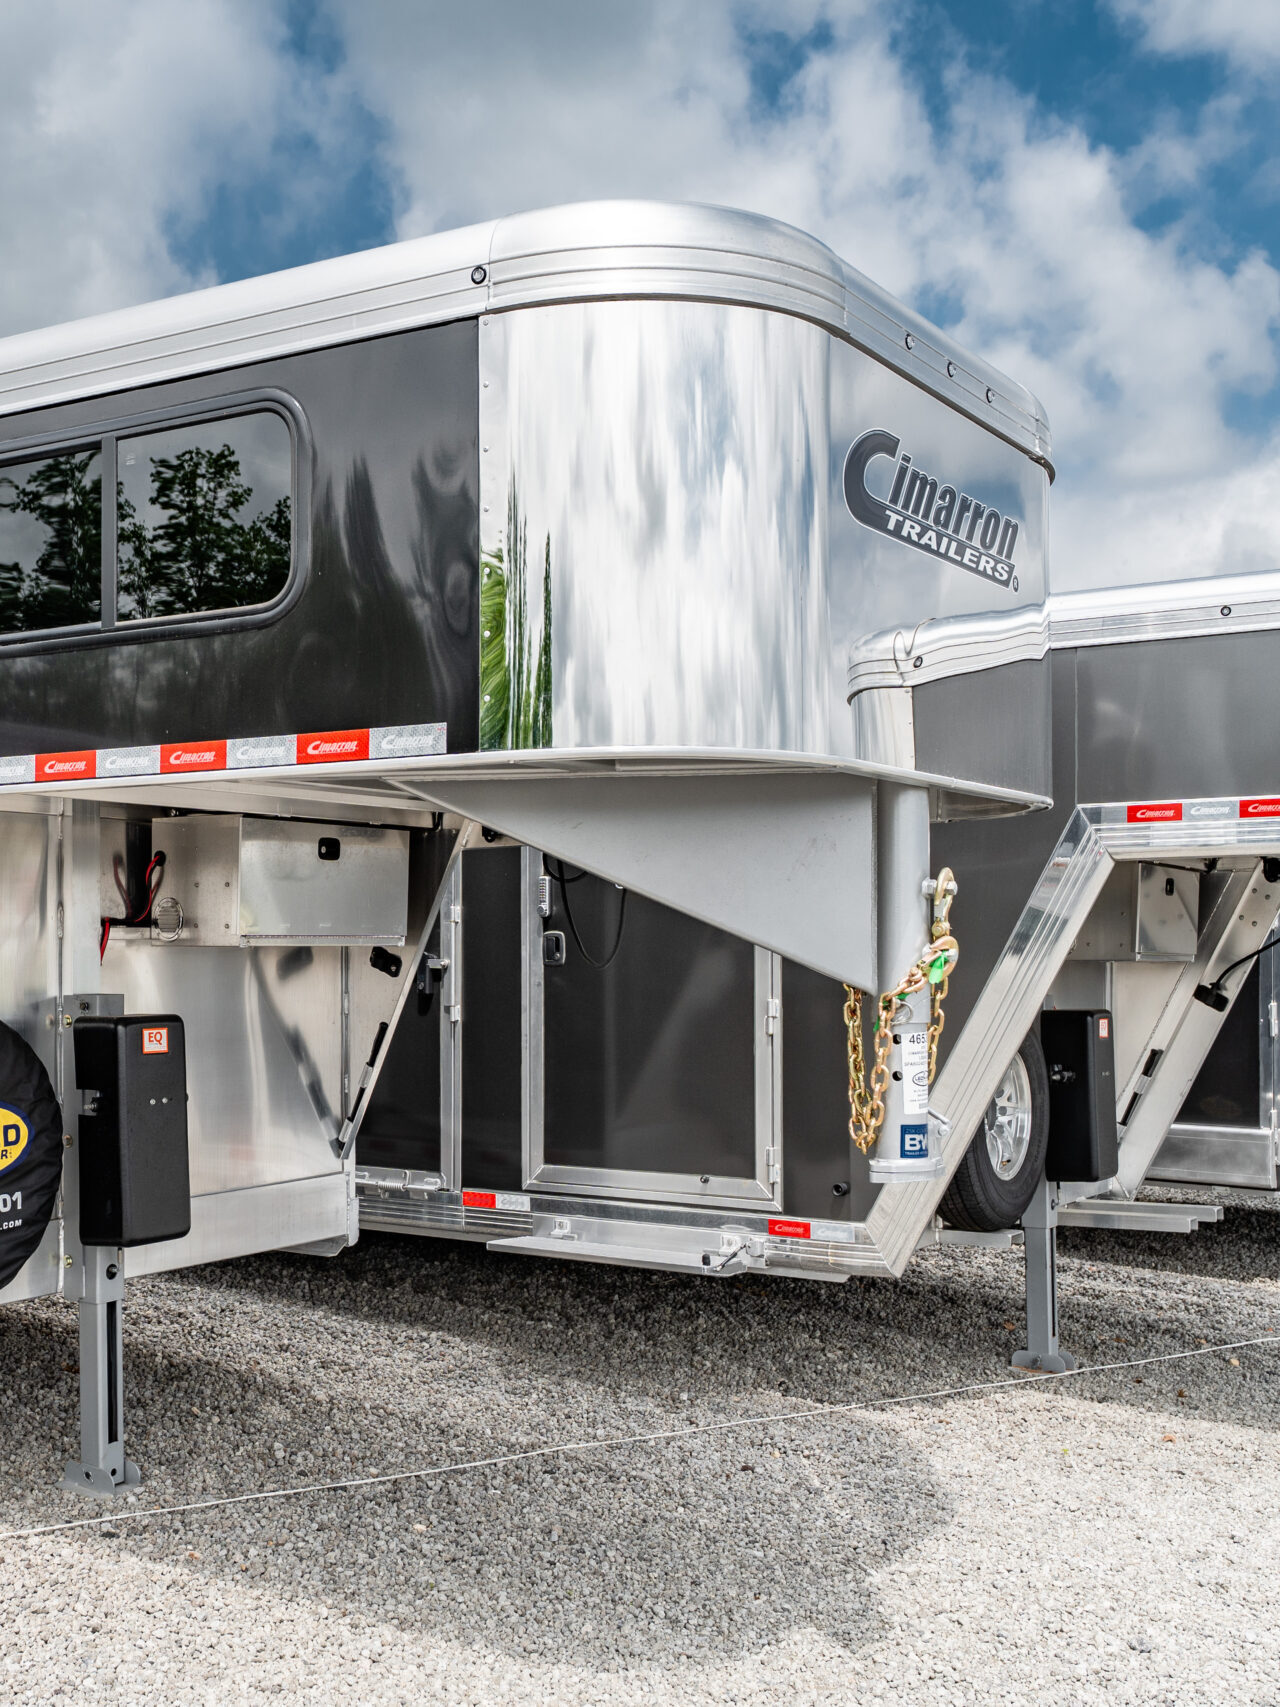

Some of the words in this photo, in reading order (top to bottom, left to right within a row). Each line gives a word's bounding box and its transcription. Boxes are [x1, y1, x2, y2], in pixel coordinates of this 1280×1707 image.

[843, 428, 1019, 562] Cimarron
[885, 510, 1009, 581] TRAILERS
[307, 740, 359, 754] Cimarron
[148, 1031, 163, 1045] EQ
